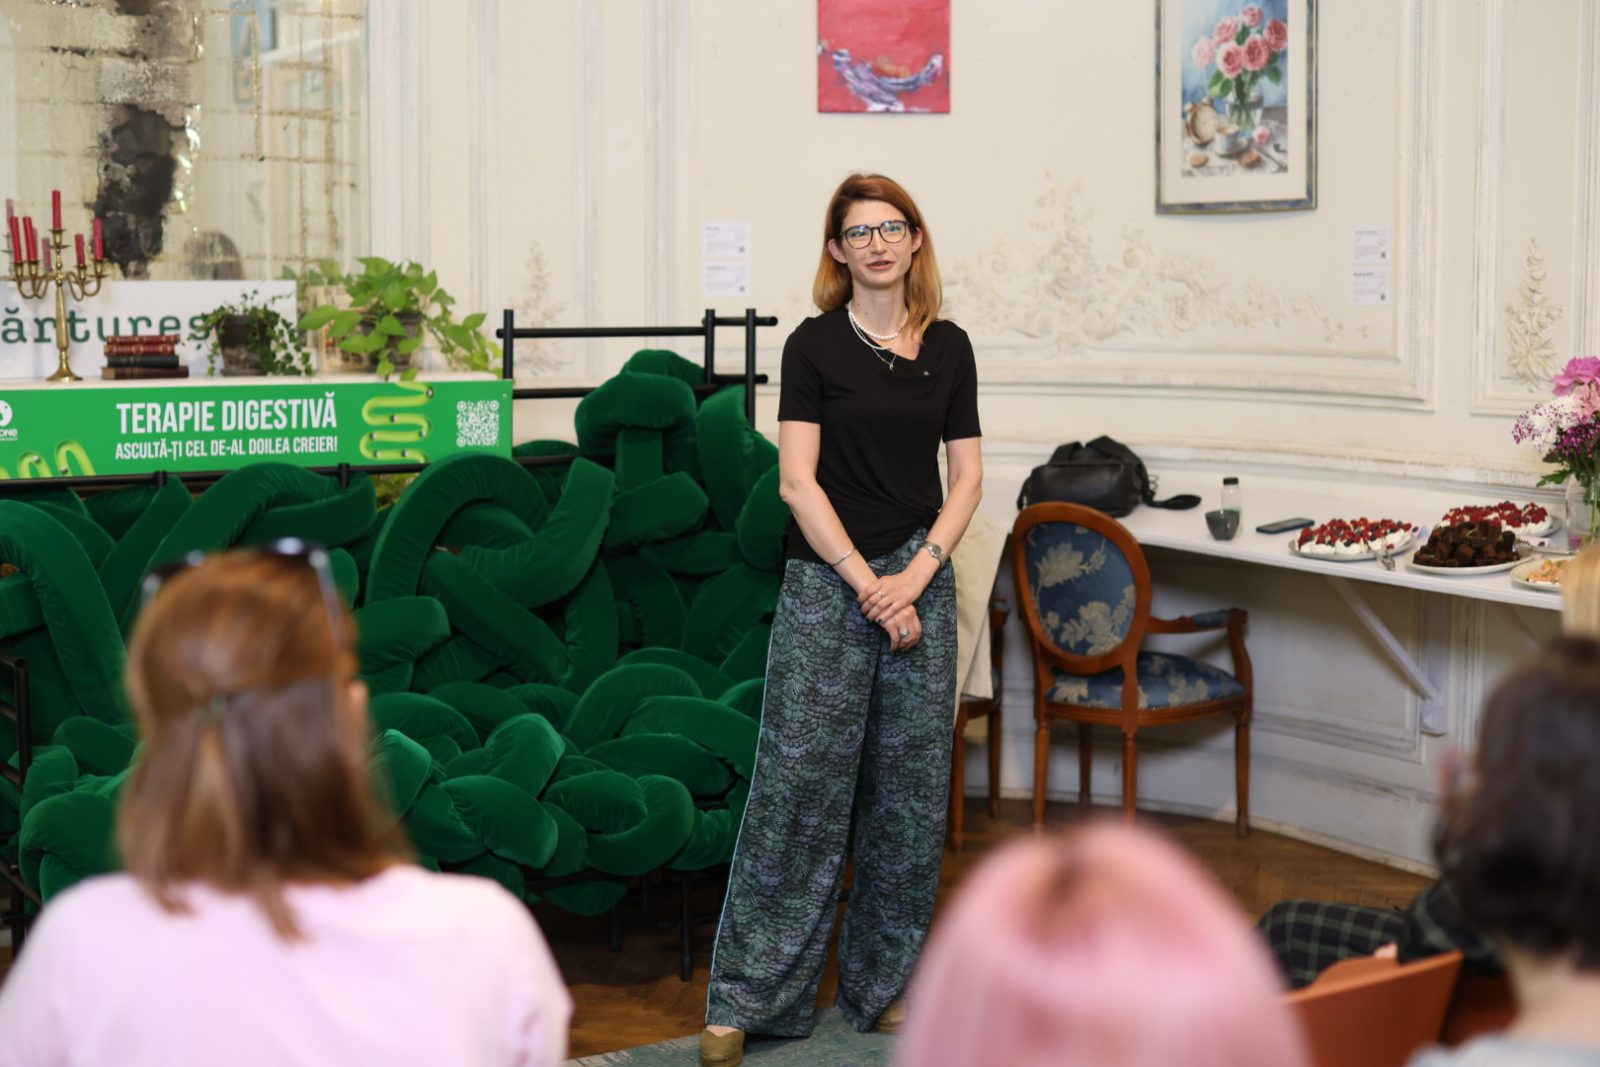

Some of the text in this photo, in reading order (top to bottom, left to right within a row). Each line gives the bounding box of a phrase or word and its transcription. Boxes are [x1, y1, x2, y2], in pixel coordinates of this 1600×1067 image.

[116, 392, 337, 434] TERAPIE DIGESTIVĂ
[186, 440, 208, 457] CEL
[210, 438, 246, 456] DE-AL
[248, 437, 290, 455] DOILEA
[293, 436, 338, 453] CREIER!
